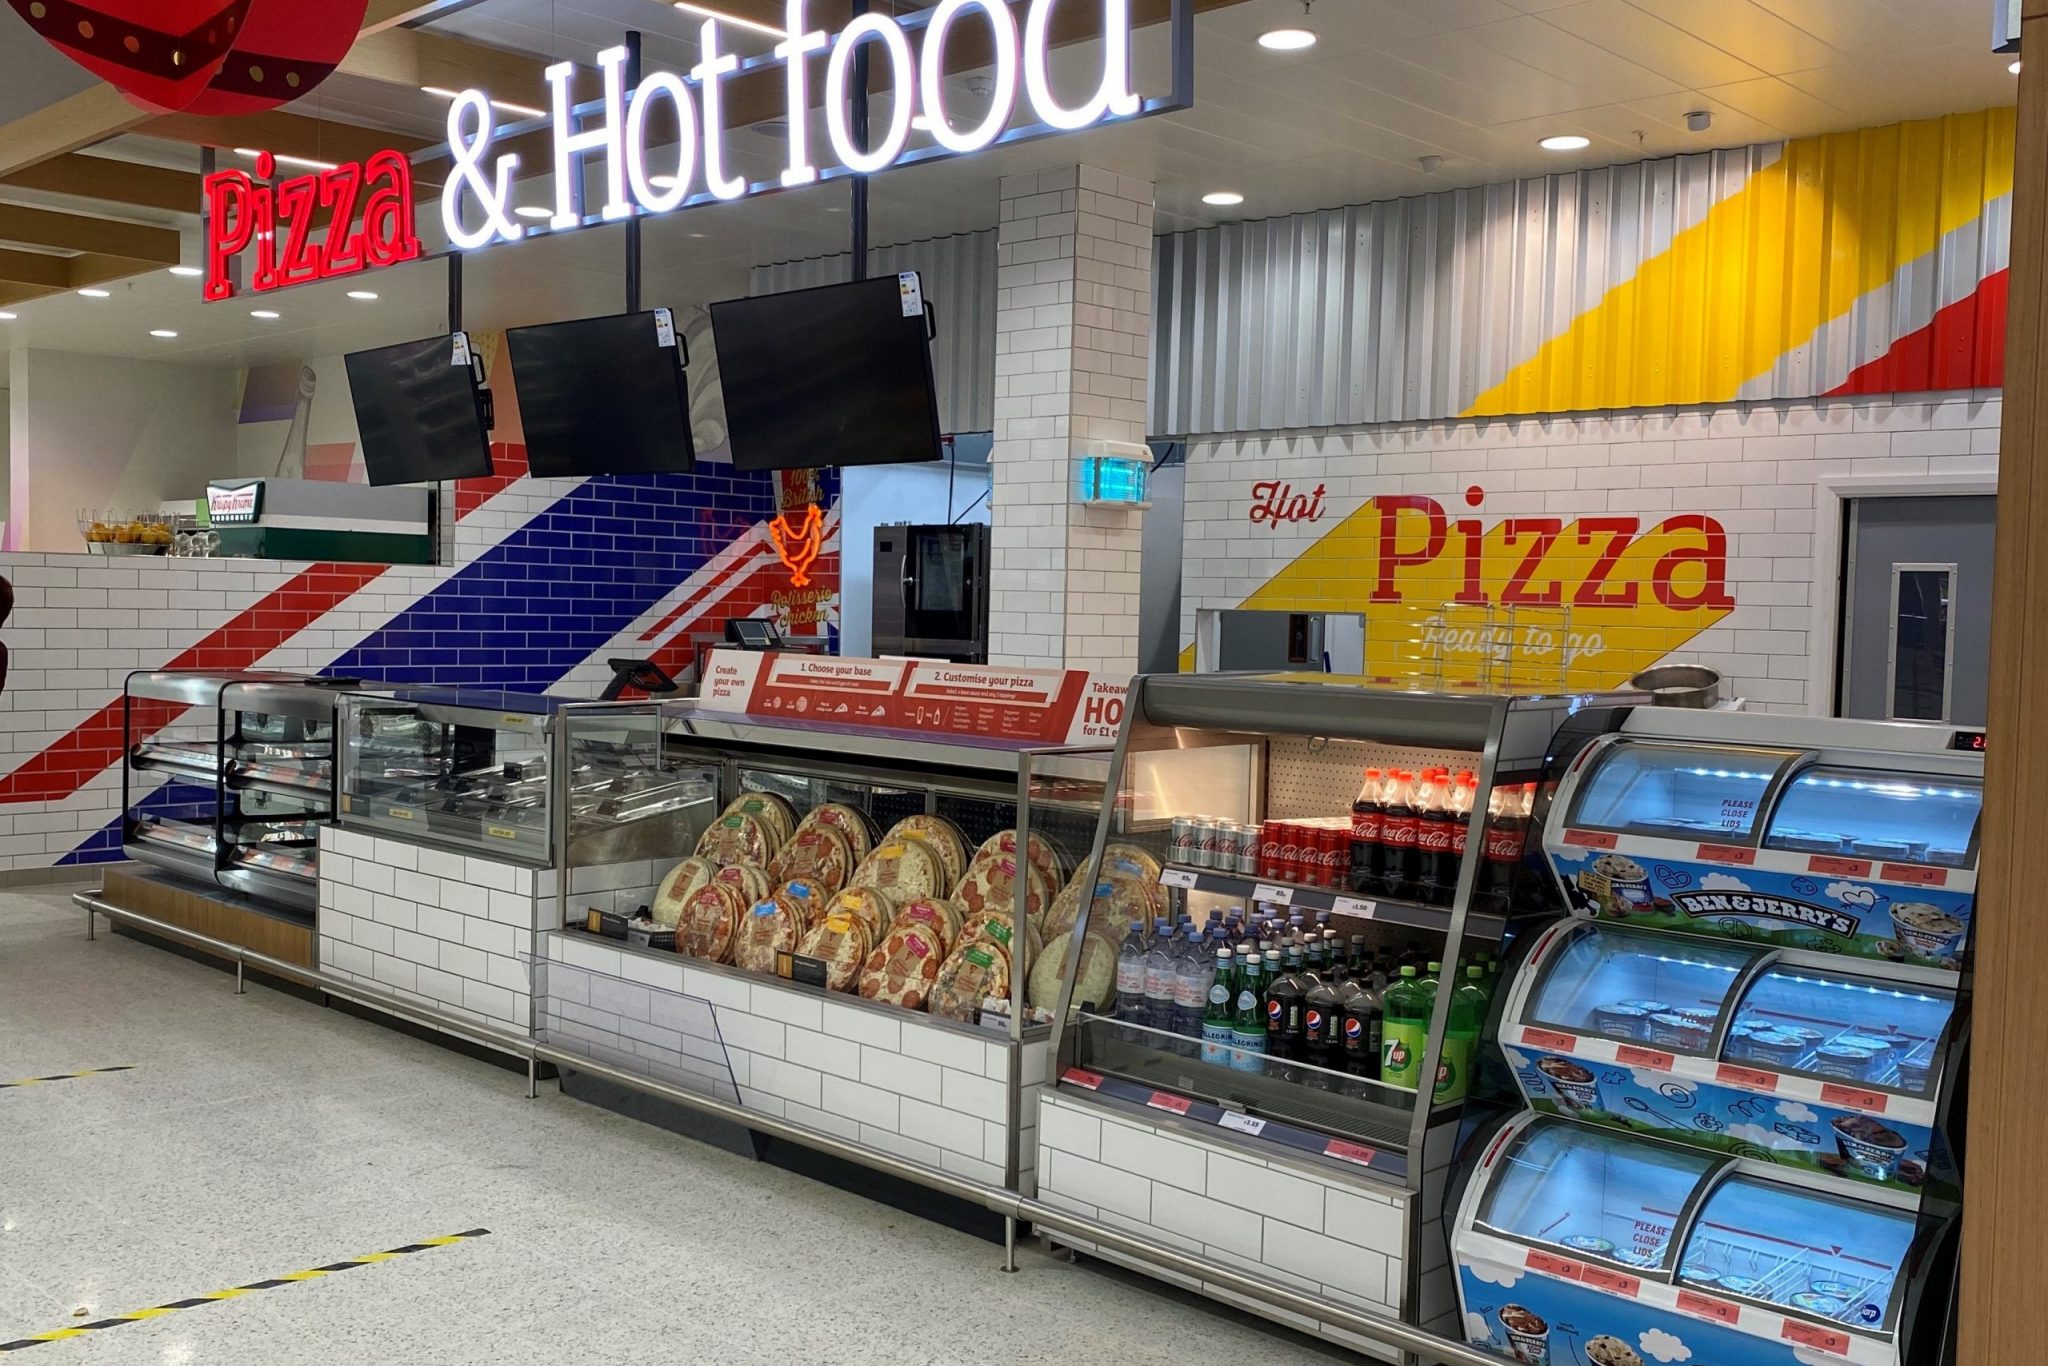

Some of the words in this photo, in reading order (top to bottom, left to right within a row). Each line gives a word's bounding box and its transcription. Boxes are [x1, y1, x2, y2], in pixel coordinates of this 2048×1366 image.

[204, 149, 421, 300] Pizza
[442, 89, 523, 248] &
[544, 18, 750, 230] Hot
[775, 0, 1140, 186] food
[1250, 481, 1326, 529] Hot
[1370, 485, 1735, 610] Pizza
[771, 587, 832, 611] Rotisserie
[1421, 616, 1513, 665] Ready
[1523, 625, 1557, 655] to
[1562, 632, 1607, 668] go
[715, 665, 738, 675] Create
[808, 663, 834, 675] Choose
[835, 667, 852, 676] your
[854, 666, 872, 676] base
[714, 678, 729, 687] your
[731, 679, 745, 687] own
[943, 672, 987, 684] Customise
[989, 676, 1008, 687] your
[1010, 677, 1034, 688] pizza
[713, 688, 730, 698] pizza
[1083, 726, 1096, 736] for
[1100, 727, 1110, 737] £1
[1722, 800, 1754, 810] PLEASE
[1721, 809, 1748, 818] CLOSE
[1721, 820, 1741, 828] LIDS
[1635, 1220, 1667, 1236] PLEASE
[1633, 1234, 1660, 1247] CLOSE
[1633, 1246, 1653, 1258] LIDS
